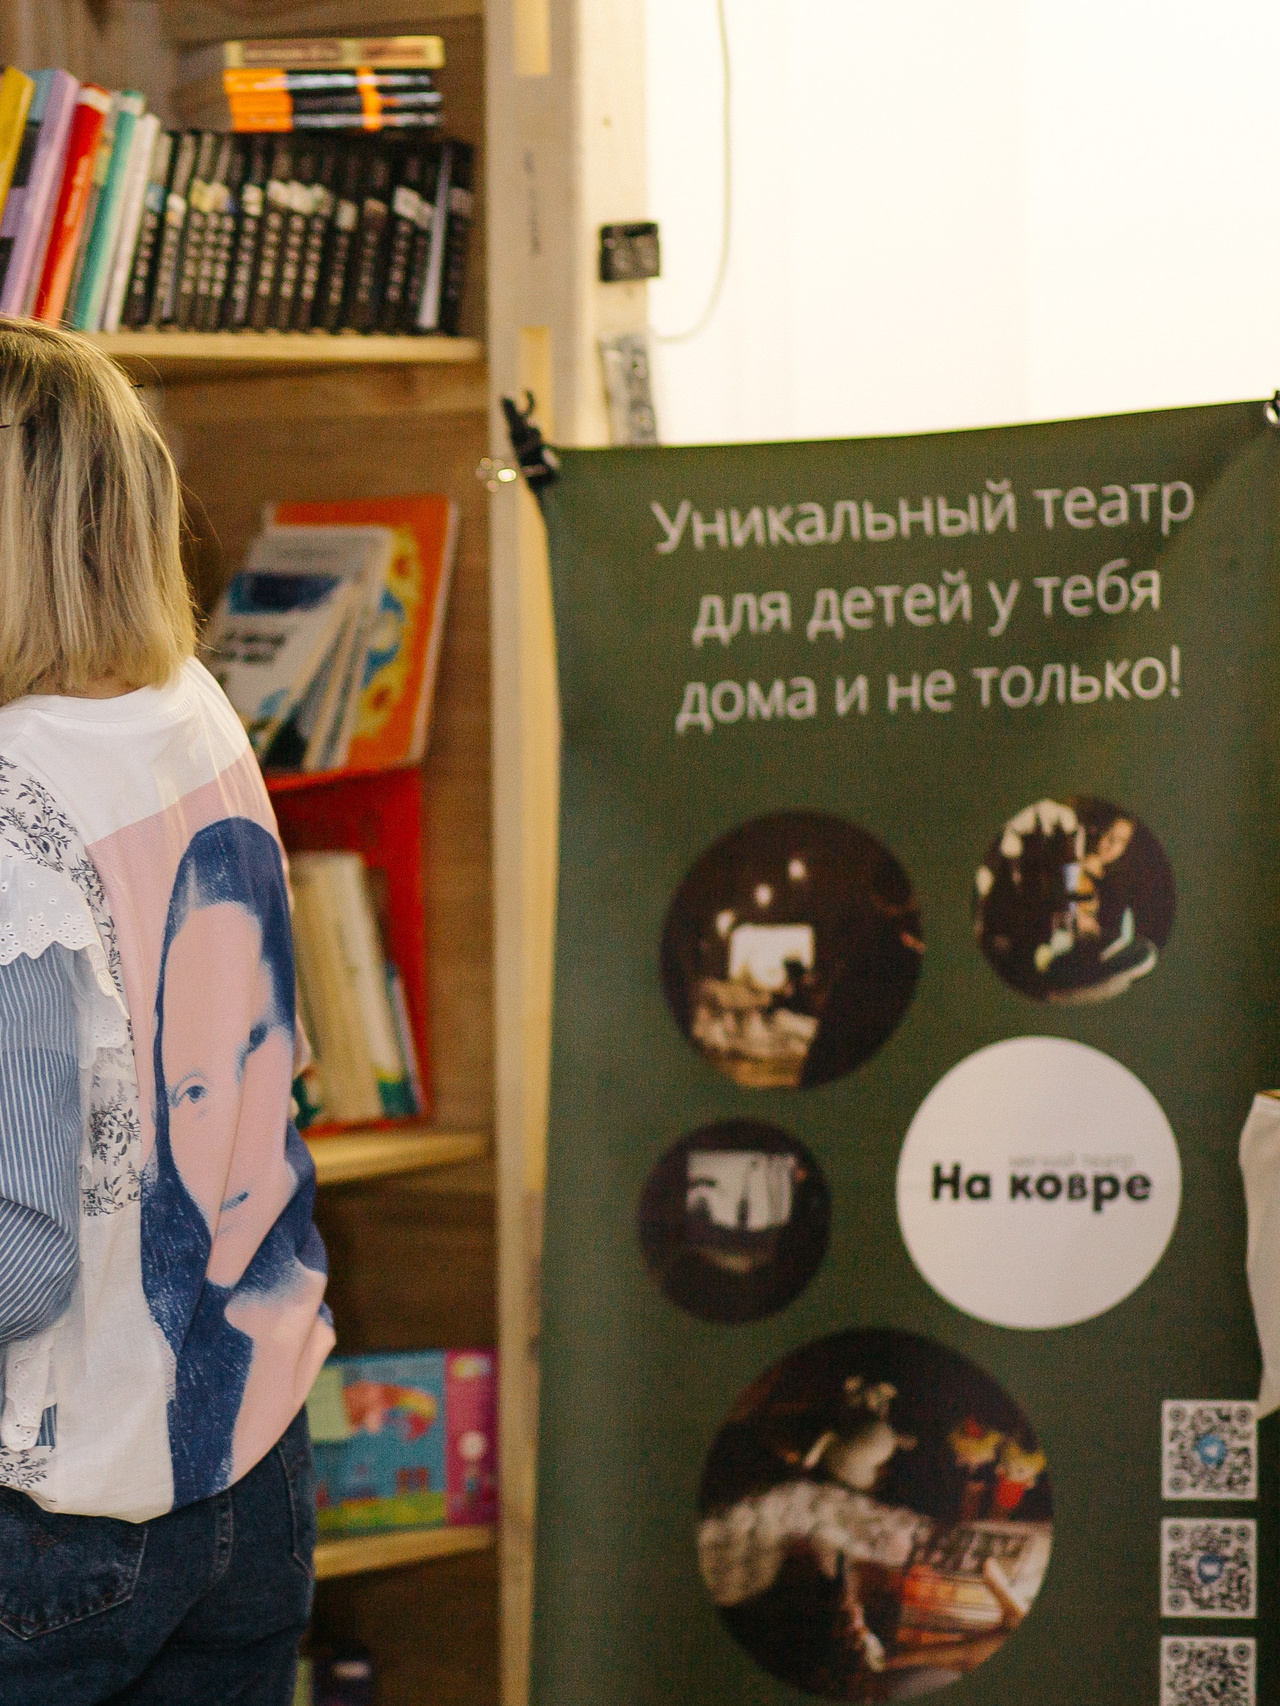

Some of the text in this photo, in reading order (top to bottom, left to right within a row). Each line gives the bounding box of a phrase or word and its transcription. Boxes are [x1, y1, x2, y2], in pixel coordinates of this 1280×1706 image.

[651, 477, 1194, 553] Уникальный театр
[692, 558, 1161, 646] для детей у тебя
[674, 644, 1182, 734] дома и не только!
[931, 1162, 1152, 1213] На ковре
